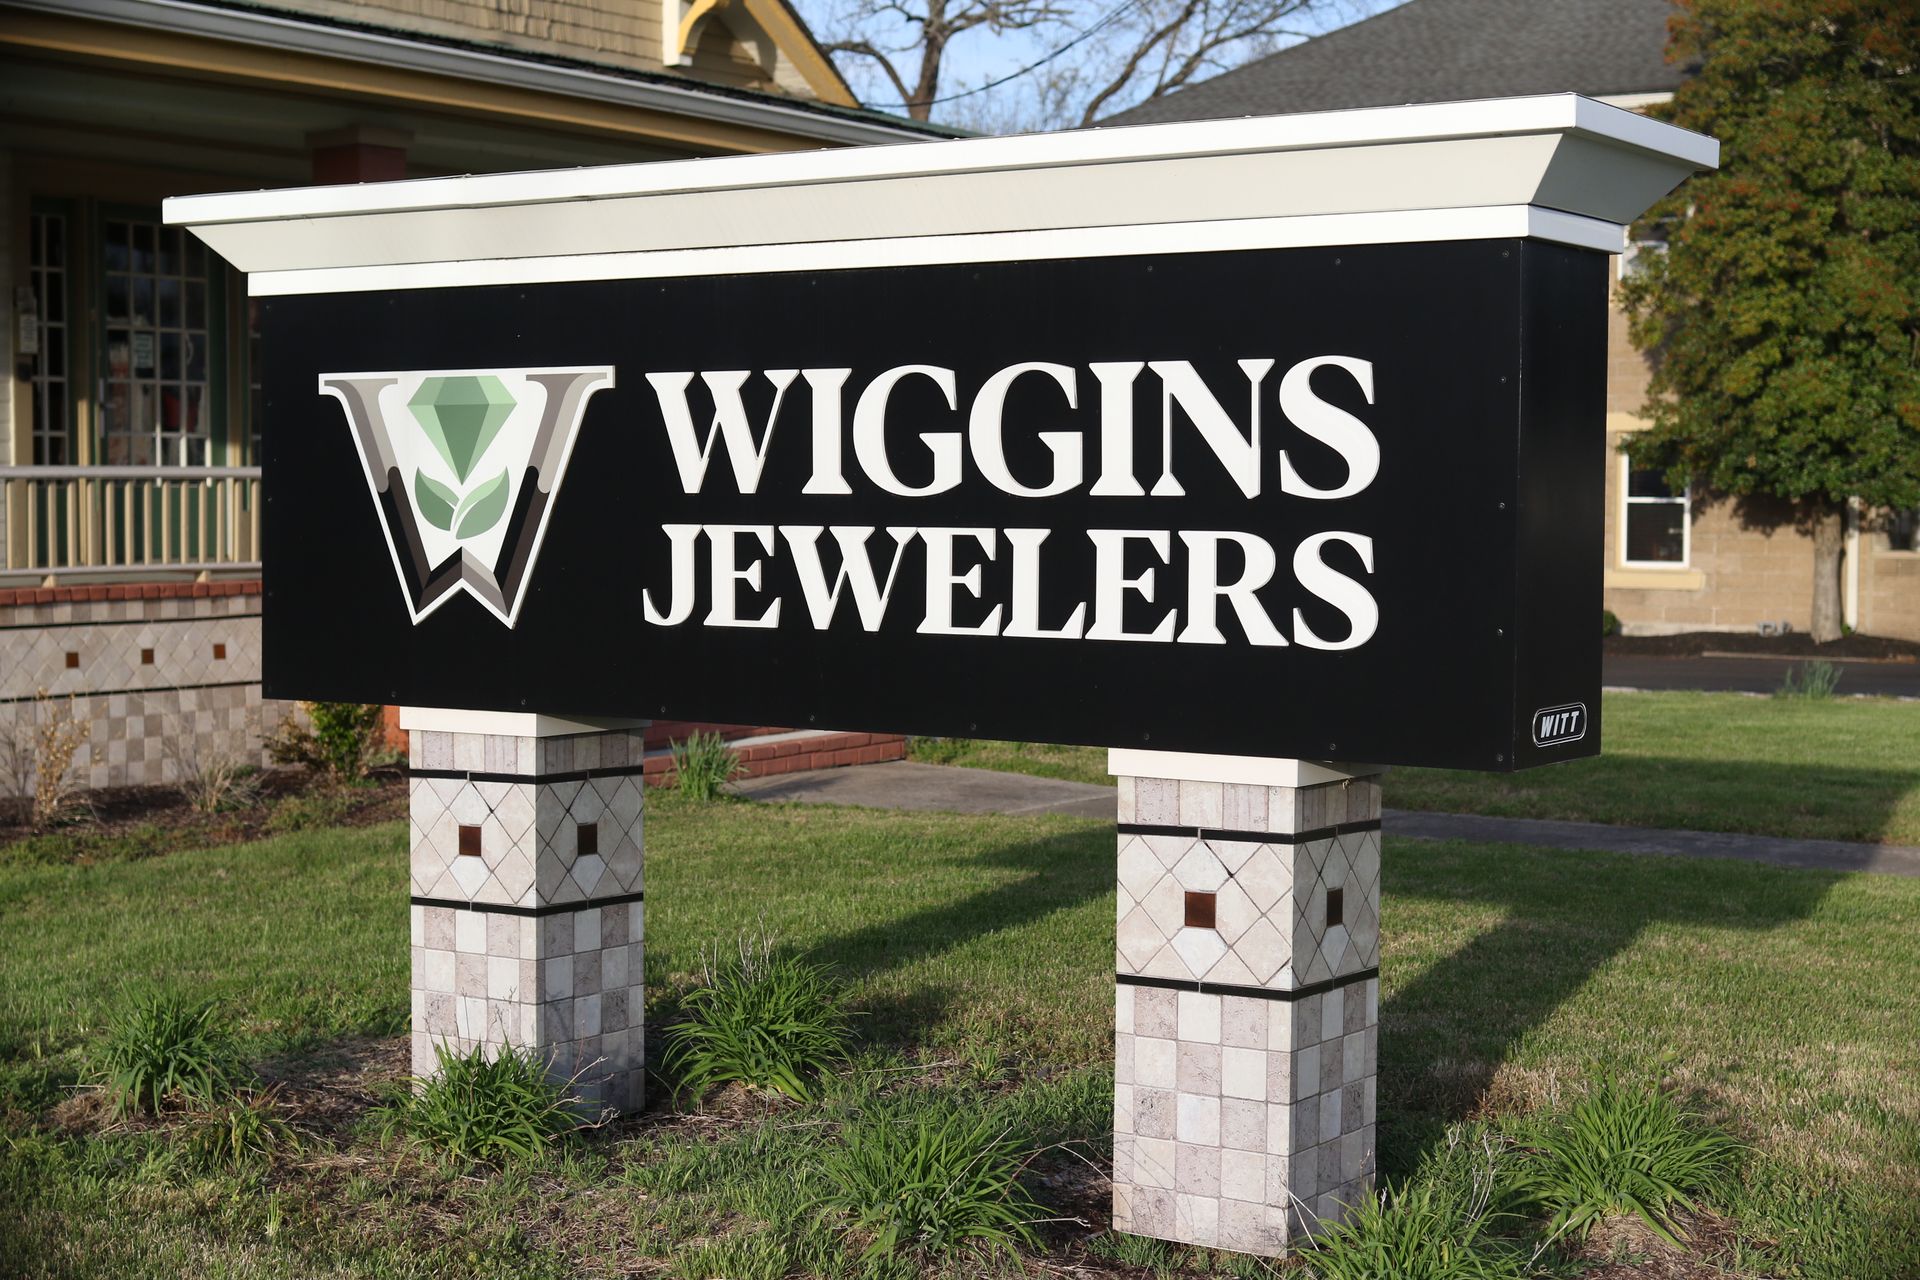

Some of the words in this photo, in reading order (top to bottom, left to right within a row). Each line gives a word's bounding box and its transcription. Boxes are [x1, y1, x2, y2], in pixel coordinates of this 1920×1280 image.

[644, 355, 1381, 500] WIGGINS
[642, 523, 1380, 651] JEWELERS
[1540, 710, 1580, 738] WITT
